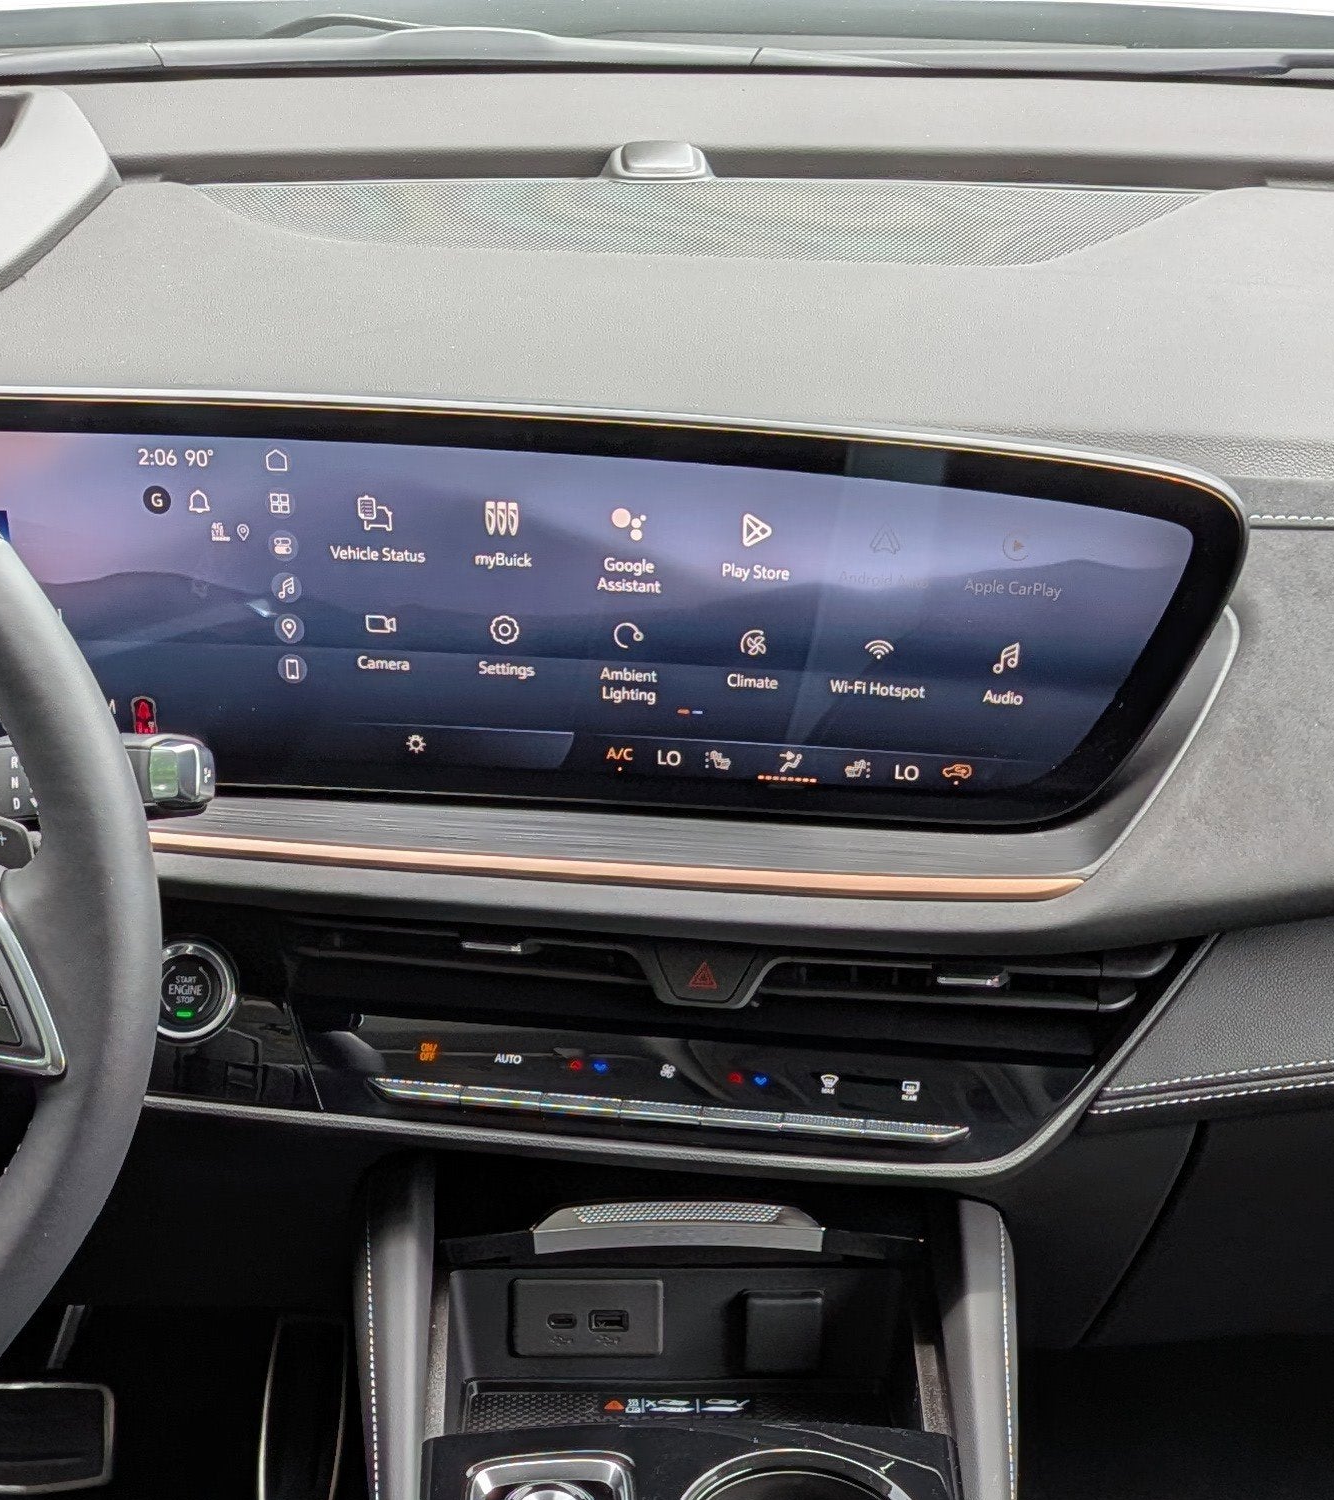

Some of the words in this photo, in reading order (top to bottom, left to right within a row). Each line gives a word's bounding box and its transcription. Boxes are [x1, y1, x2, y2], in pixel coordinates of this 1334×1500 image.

[138, 447, 178, 467] 2:06
[185, 446, 214, 467] 90°
[151, 493, 163, 507] G
[330, 546, 378, 563] Vehicle
[382, 547, 426, 564] Status
[475, 553, 532, 569] myBuick
[604, 557, 655, 576] Google
[722, 563, 751, 582] Play
[754, 564, 790, 582] Store
[597, 578, 661, 594] Assistant
[838, 571, 893, 587] Android
[965, 578, 1005, 596] Apple
[1009, 581, 1062, 601] CarPlay
[357, 656, 410, 672] Camera
[479, 660, 535, 679] Settings
[600, 667, 657, 683] Ambient
[727, 673, 778, 691] Climate
[602, 686, 656, 705] Lighting
[830, 679, 867, 696] Wi-Fi
[869, 682, 925, 702] Hotspot
[983, 690, 1023, 706] Audio
[606, 747, 633, 763] A/C
[657, 749, 681, 767] LO
[894, 764, 919, 782] LO
[11, 777, 19, 789] N
[13, 798, 20, 810] D
[175, 975, 197, 984] START
[168, 984, 203, 996] ENGINE
[175, 996, 194, 1004] STOP
[494, 1053, 522, 1065] AUTO
